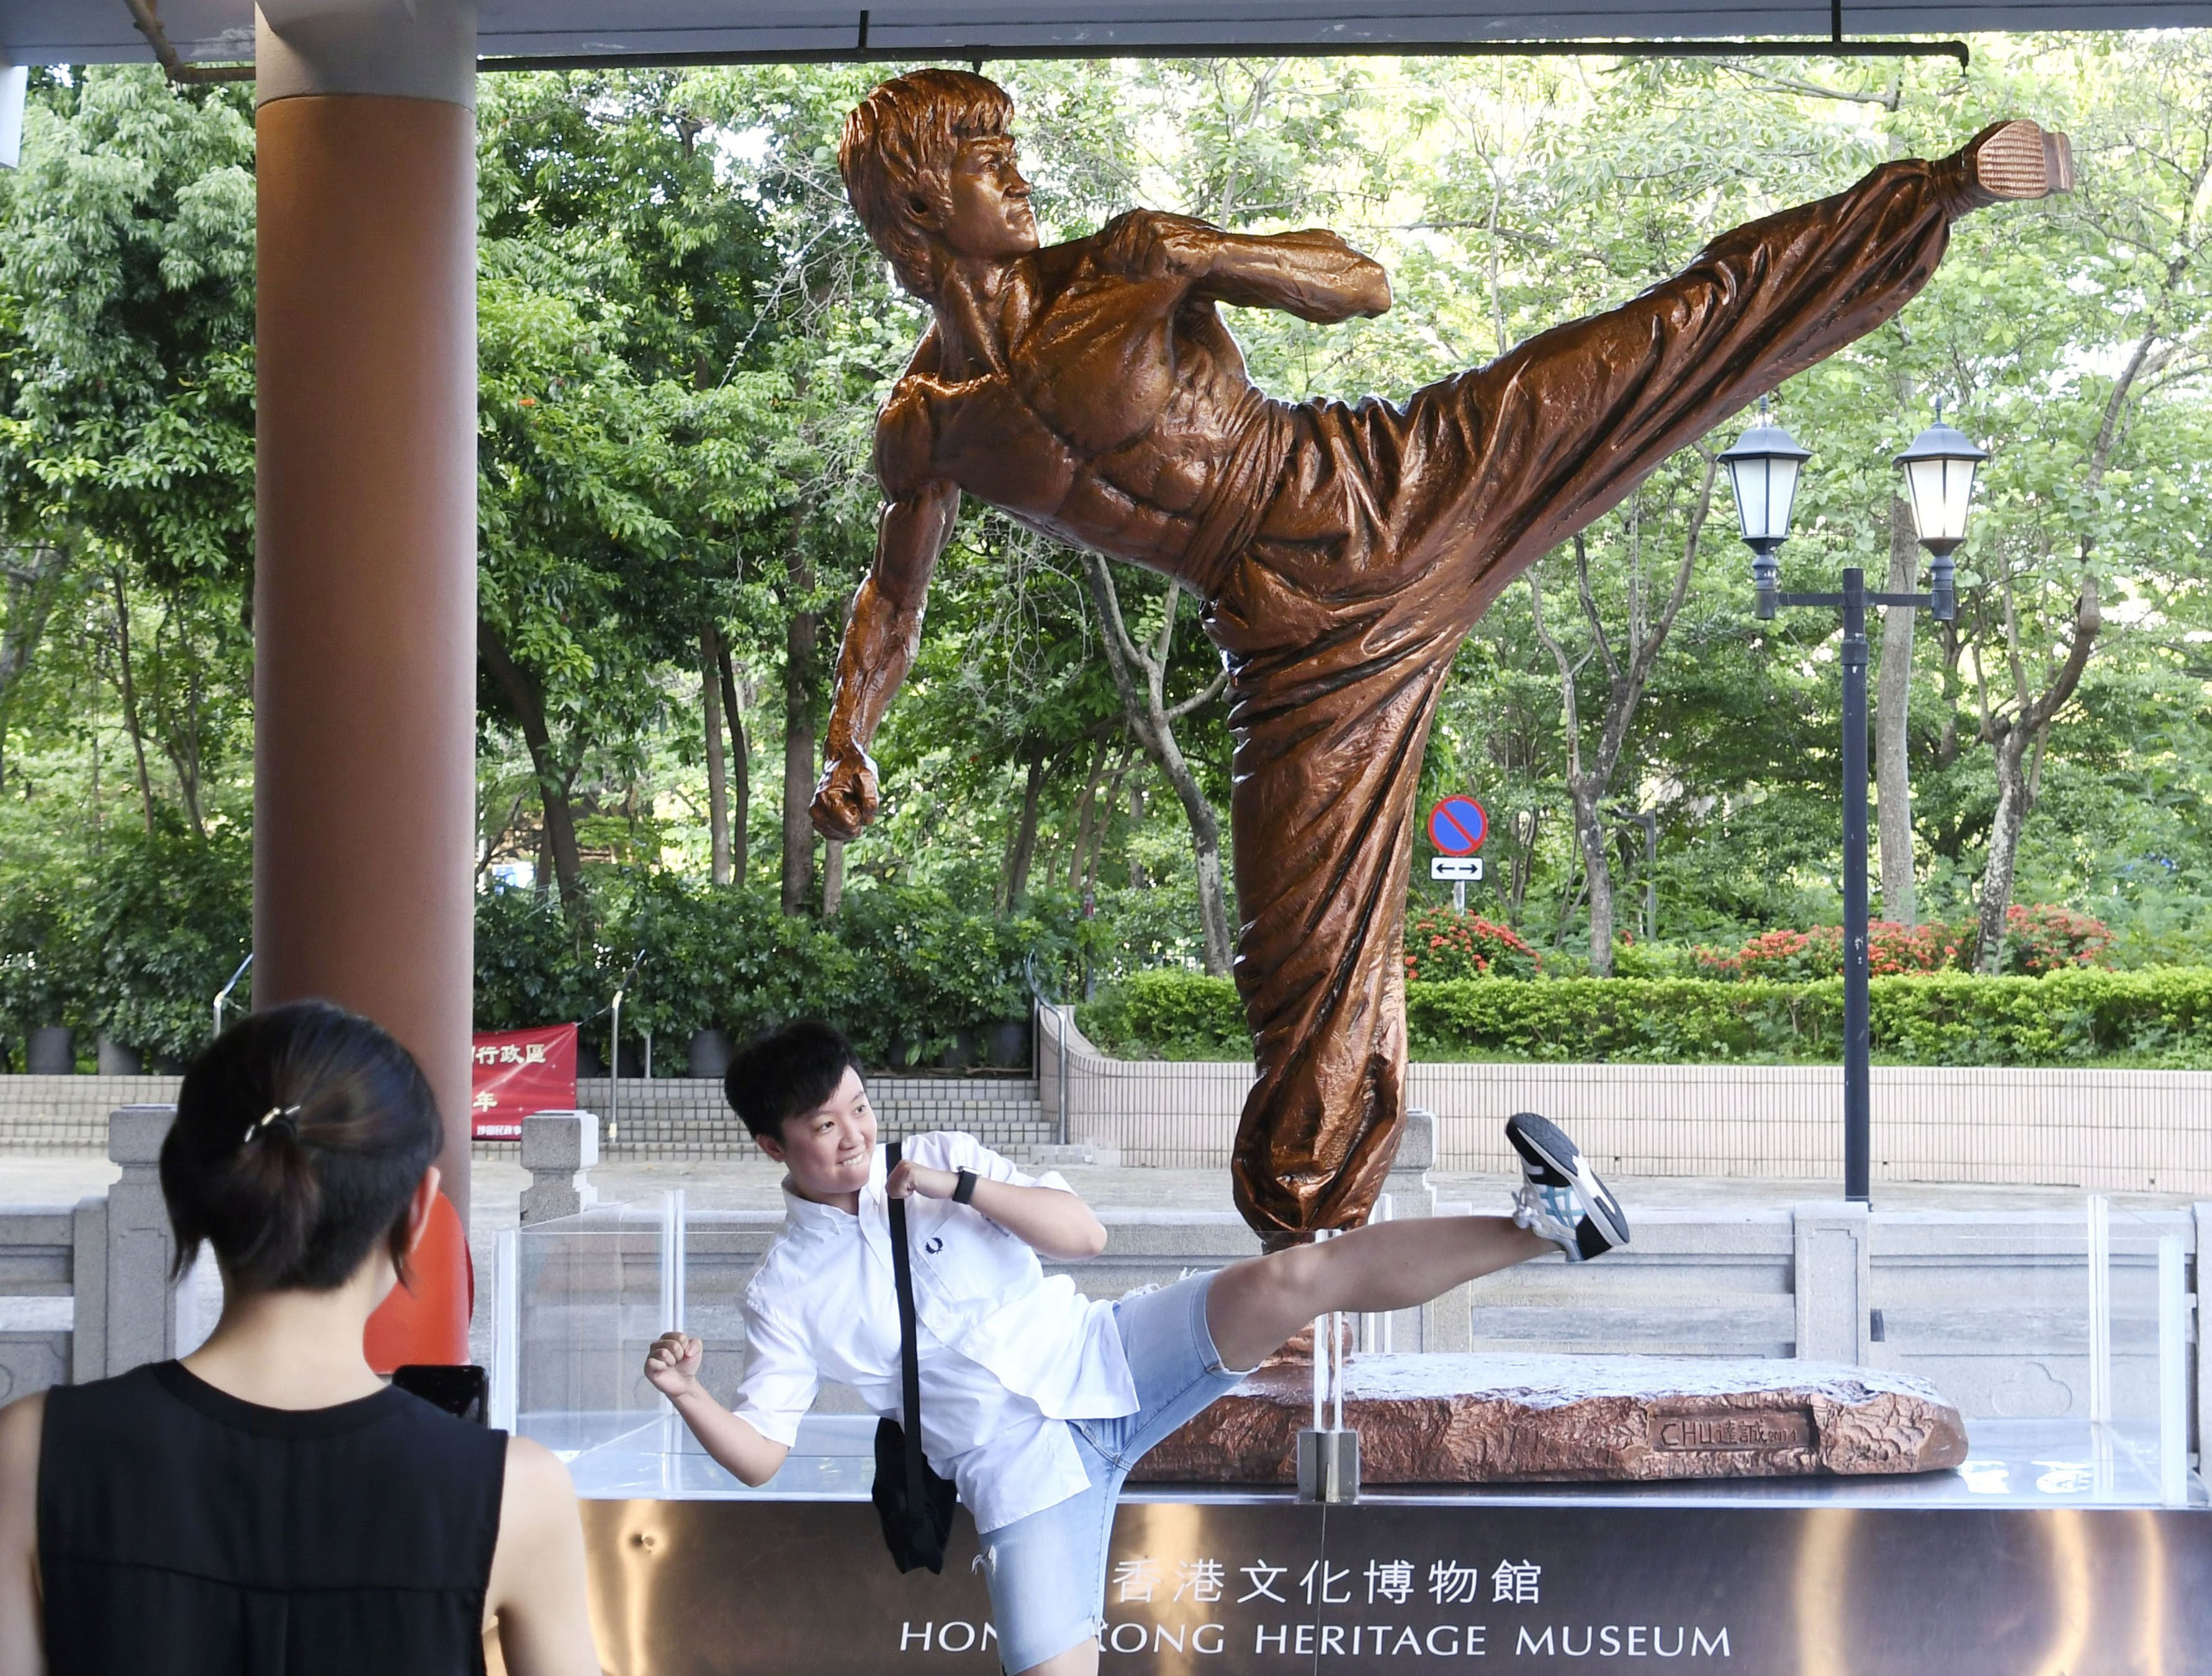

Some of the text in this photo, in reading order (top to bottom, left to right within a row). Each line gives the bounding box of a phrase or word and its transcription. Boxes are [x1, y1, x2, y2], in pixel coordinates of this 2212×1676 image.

[472, 1043, 546, 1065] 行政區
[472, 1091, 498, 1112] 年
[1661, 1421, 1713, 1446] CHU
[1112, 1558, 1542, 1605] 香港文化博物館
[899, 1621, 997, 1652] HON
[1255, 1624, 1487, 1656] HERITAGE
[1515, 1624, 1731, 1657] MUSEUM
